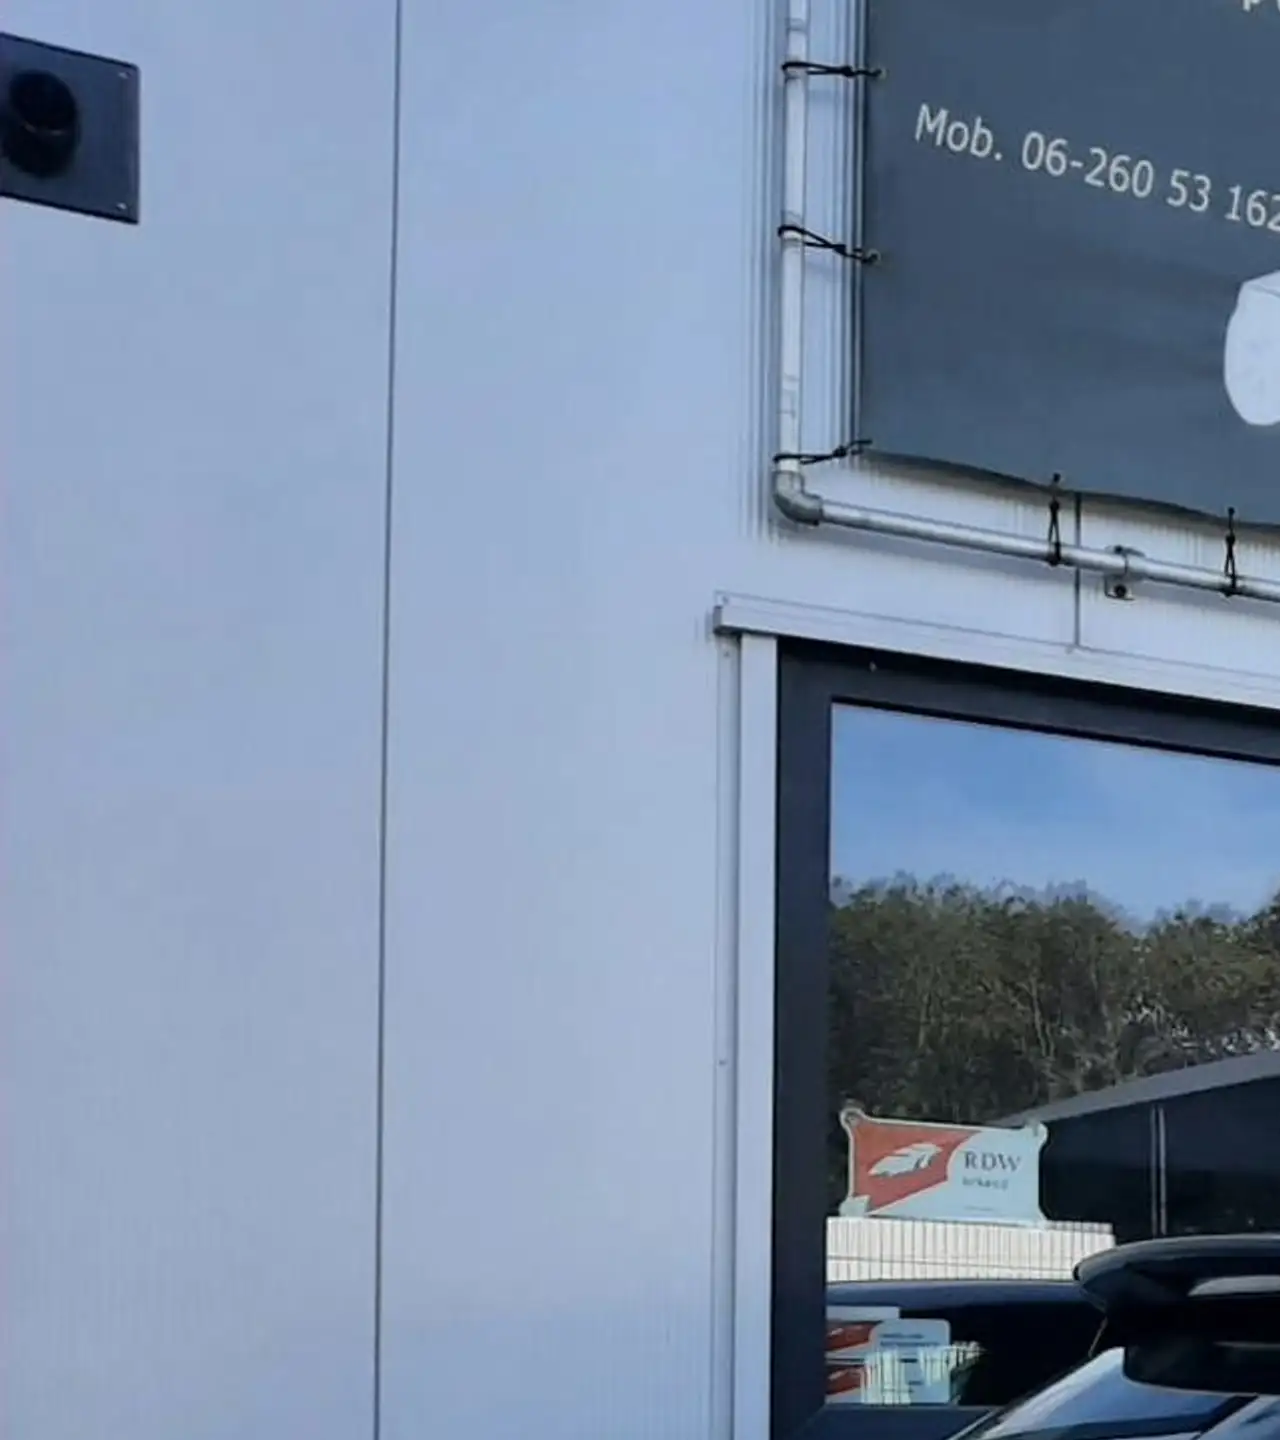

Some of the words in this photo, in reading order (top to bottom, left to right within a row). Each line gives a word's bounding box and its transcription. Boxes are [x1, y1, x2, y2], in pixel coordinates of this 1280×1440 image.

[915, 103, 1002, 161] Mob.
[1021, 131, 1154, 198] 06-260
[1166, 168, 1212, 213] 53
[964, 1150, 1022, 1172] RDW
